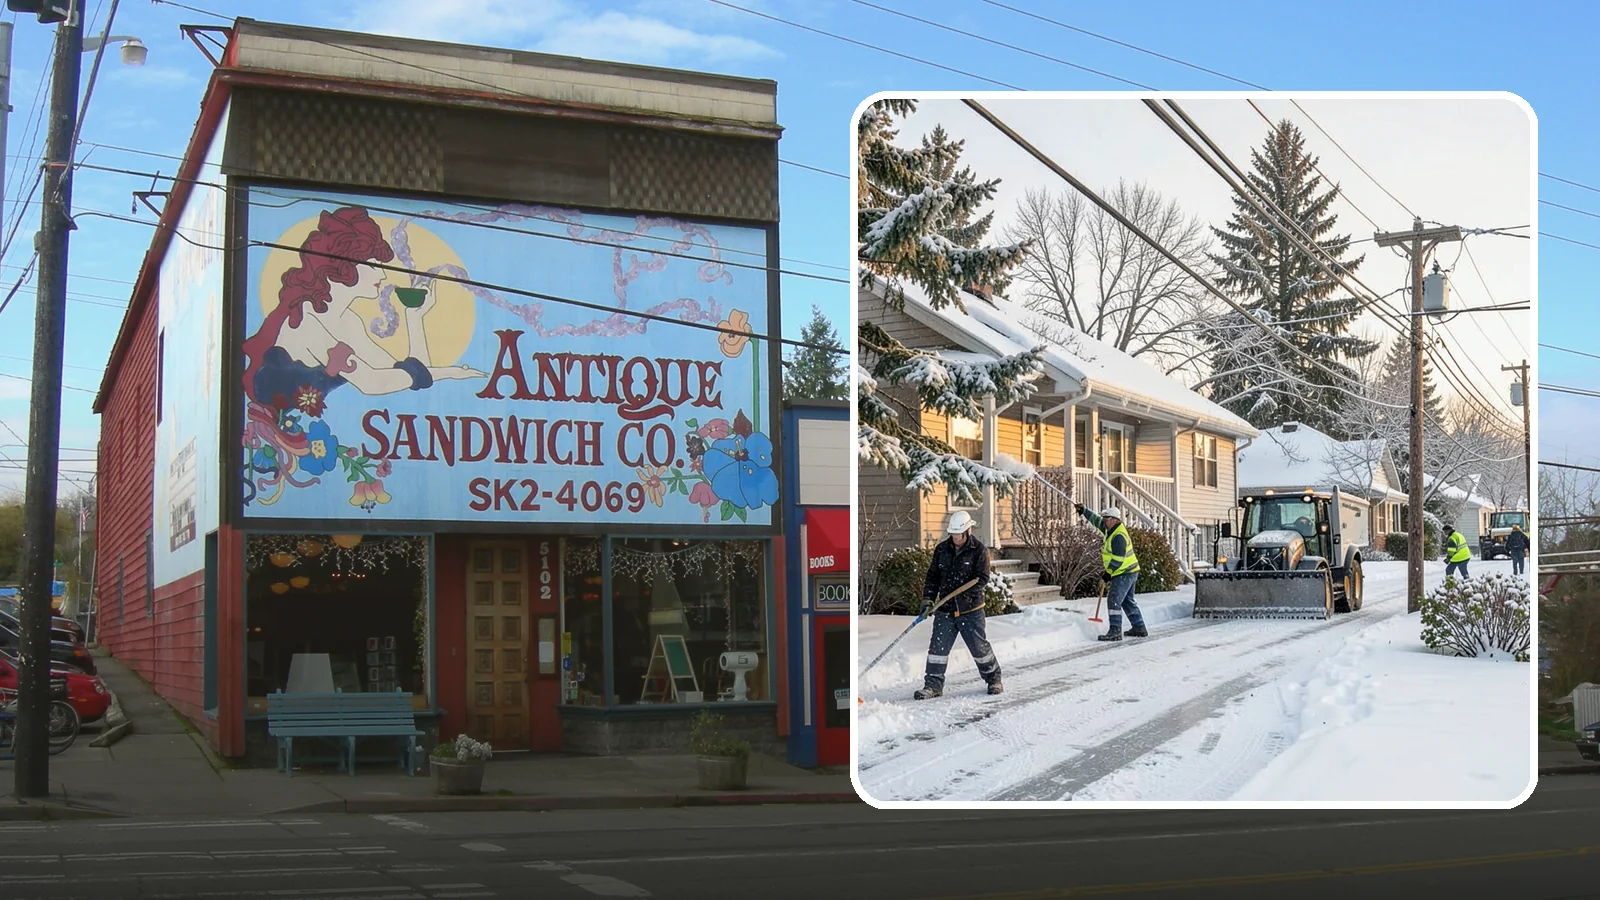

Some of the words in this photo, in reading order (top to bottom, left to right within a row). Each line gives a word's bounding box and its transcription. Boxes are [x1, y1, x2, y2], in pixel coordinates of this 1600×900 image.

[475, 329, 724, 421] ANTIQUE
[361, 408, 604, 467] SANDWICH
[616, 421, 685, 468] CO.
[468, 476, 646, 513] SK2-4069
[540, 541, 551, 600] 5102
[809, 554, 835, 569] BOOKS
